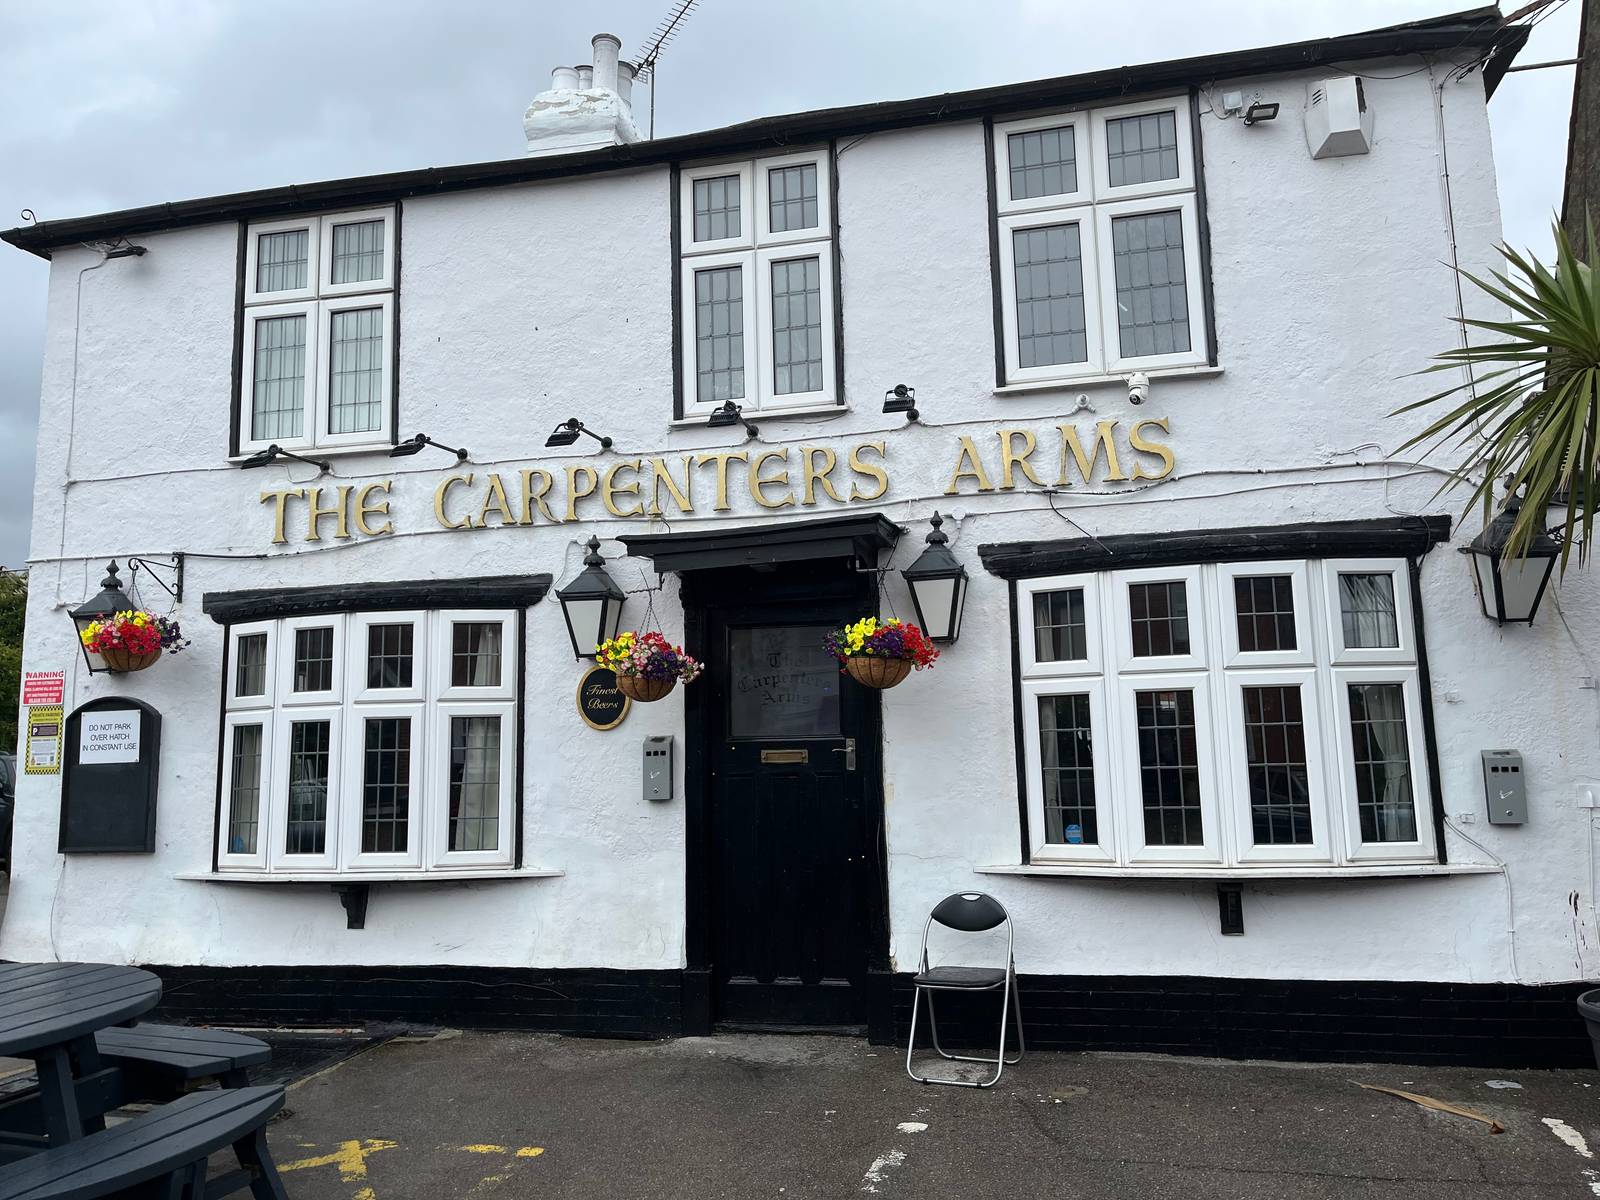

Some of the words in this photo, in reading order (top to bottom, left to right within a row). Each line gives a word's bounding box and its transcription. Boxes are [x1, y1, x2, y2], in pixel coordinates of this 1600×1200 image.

[260, 478, 395, 545] THE
[432, 440, 890, 529] CARPENTERS
[943, 415, 1177, 496] ARMS
[25, 671, 64, 679] WARNING
[586, 684, 620, 696] Finest
[587, 697, 620, 710] Beers
[115, 722, 132, 730] PARK
[90, 734, 108, 742] OVER
[90, 743, 122, 752] CONSTANT
[124, 742, 137, 750] USE
